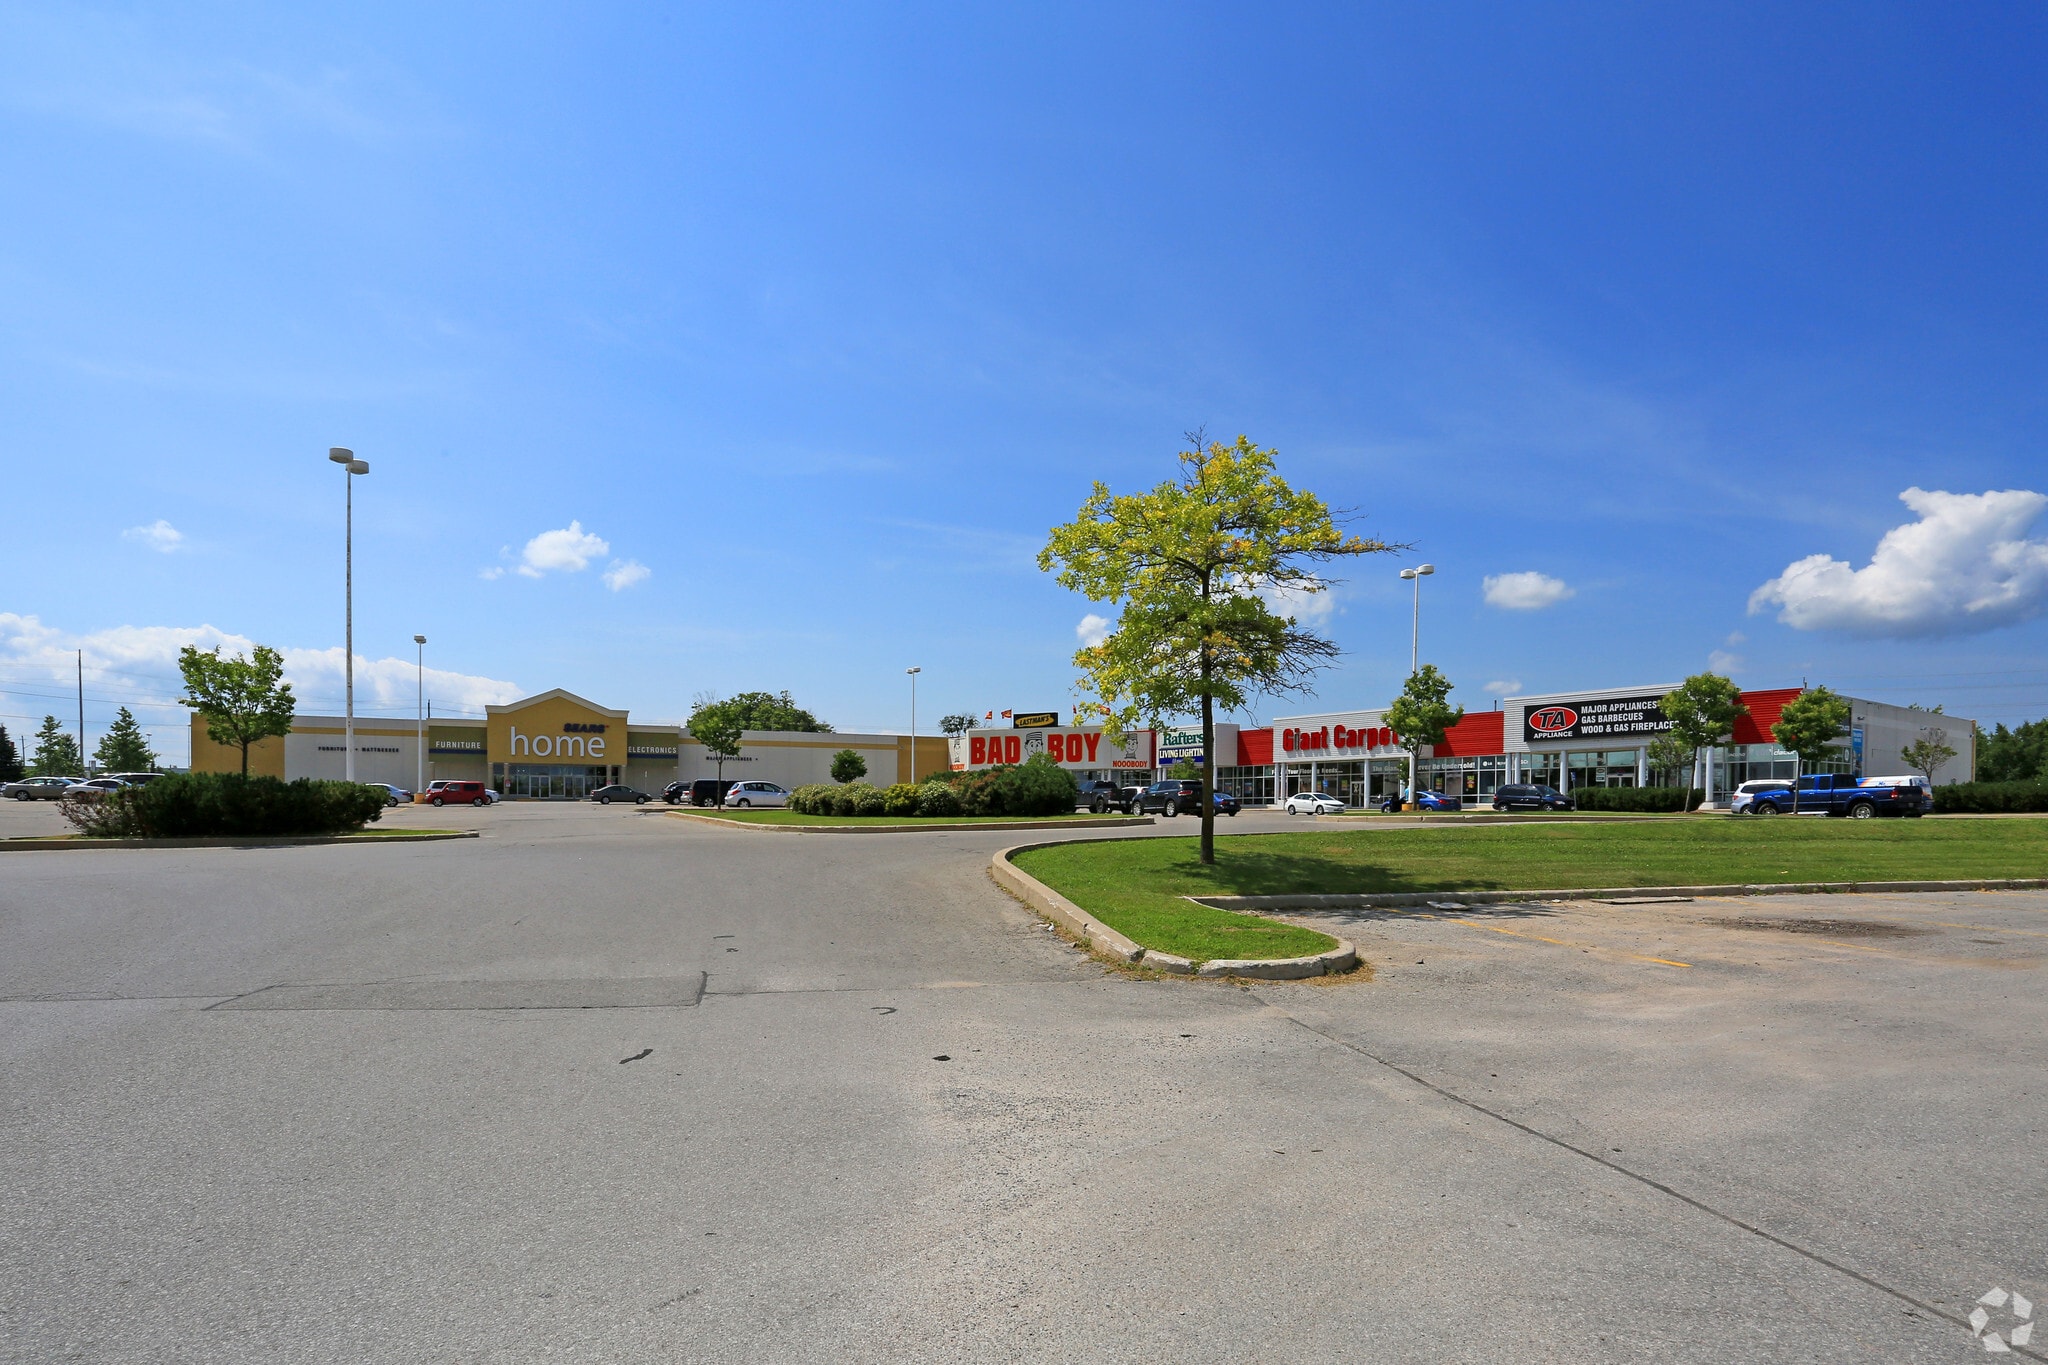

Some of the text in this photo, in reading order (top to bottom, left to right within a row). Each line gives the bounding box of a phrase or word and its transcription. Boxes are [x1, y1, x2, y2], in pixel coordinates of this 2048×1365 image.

[1581, 701, 1658, 714] MAJOR APPLIANCES
[1019, 714, 1051, 726] LASTMAN'S
[1538, 711, 1567, 728] TA
[1581, 712, 1644, 724] GAS BARBECUES
[563, 723, 605, 733] SEARS
[1581, 725, 1604, 734] WOOD
[1605, 724, 1612, 732] &
[1613, 723, 1629, 732] GAS
[1163, 732, 1204, 746] Rafters
[1283, 725, 1329, 752] Giant
[1533, 730, 1573, 740] APPLIANCE
[435, 740, 481, 749] FURNITURE
[510, 726, 606, 758] home
[628, 746, 677, 754] ELECTRONICS
[970, 733, 1102, 765] BAD BOY
[1160, 747, 1204, 758] LIVING LIGHTIN
